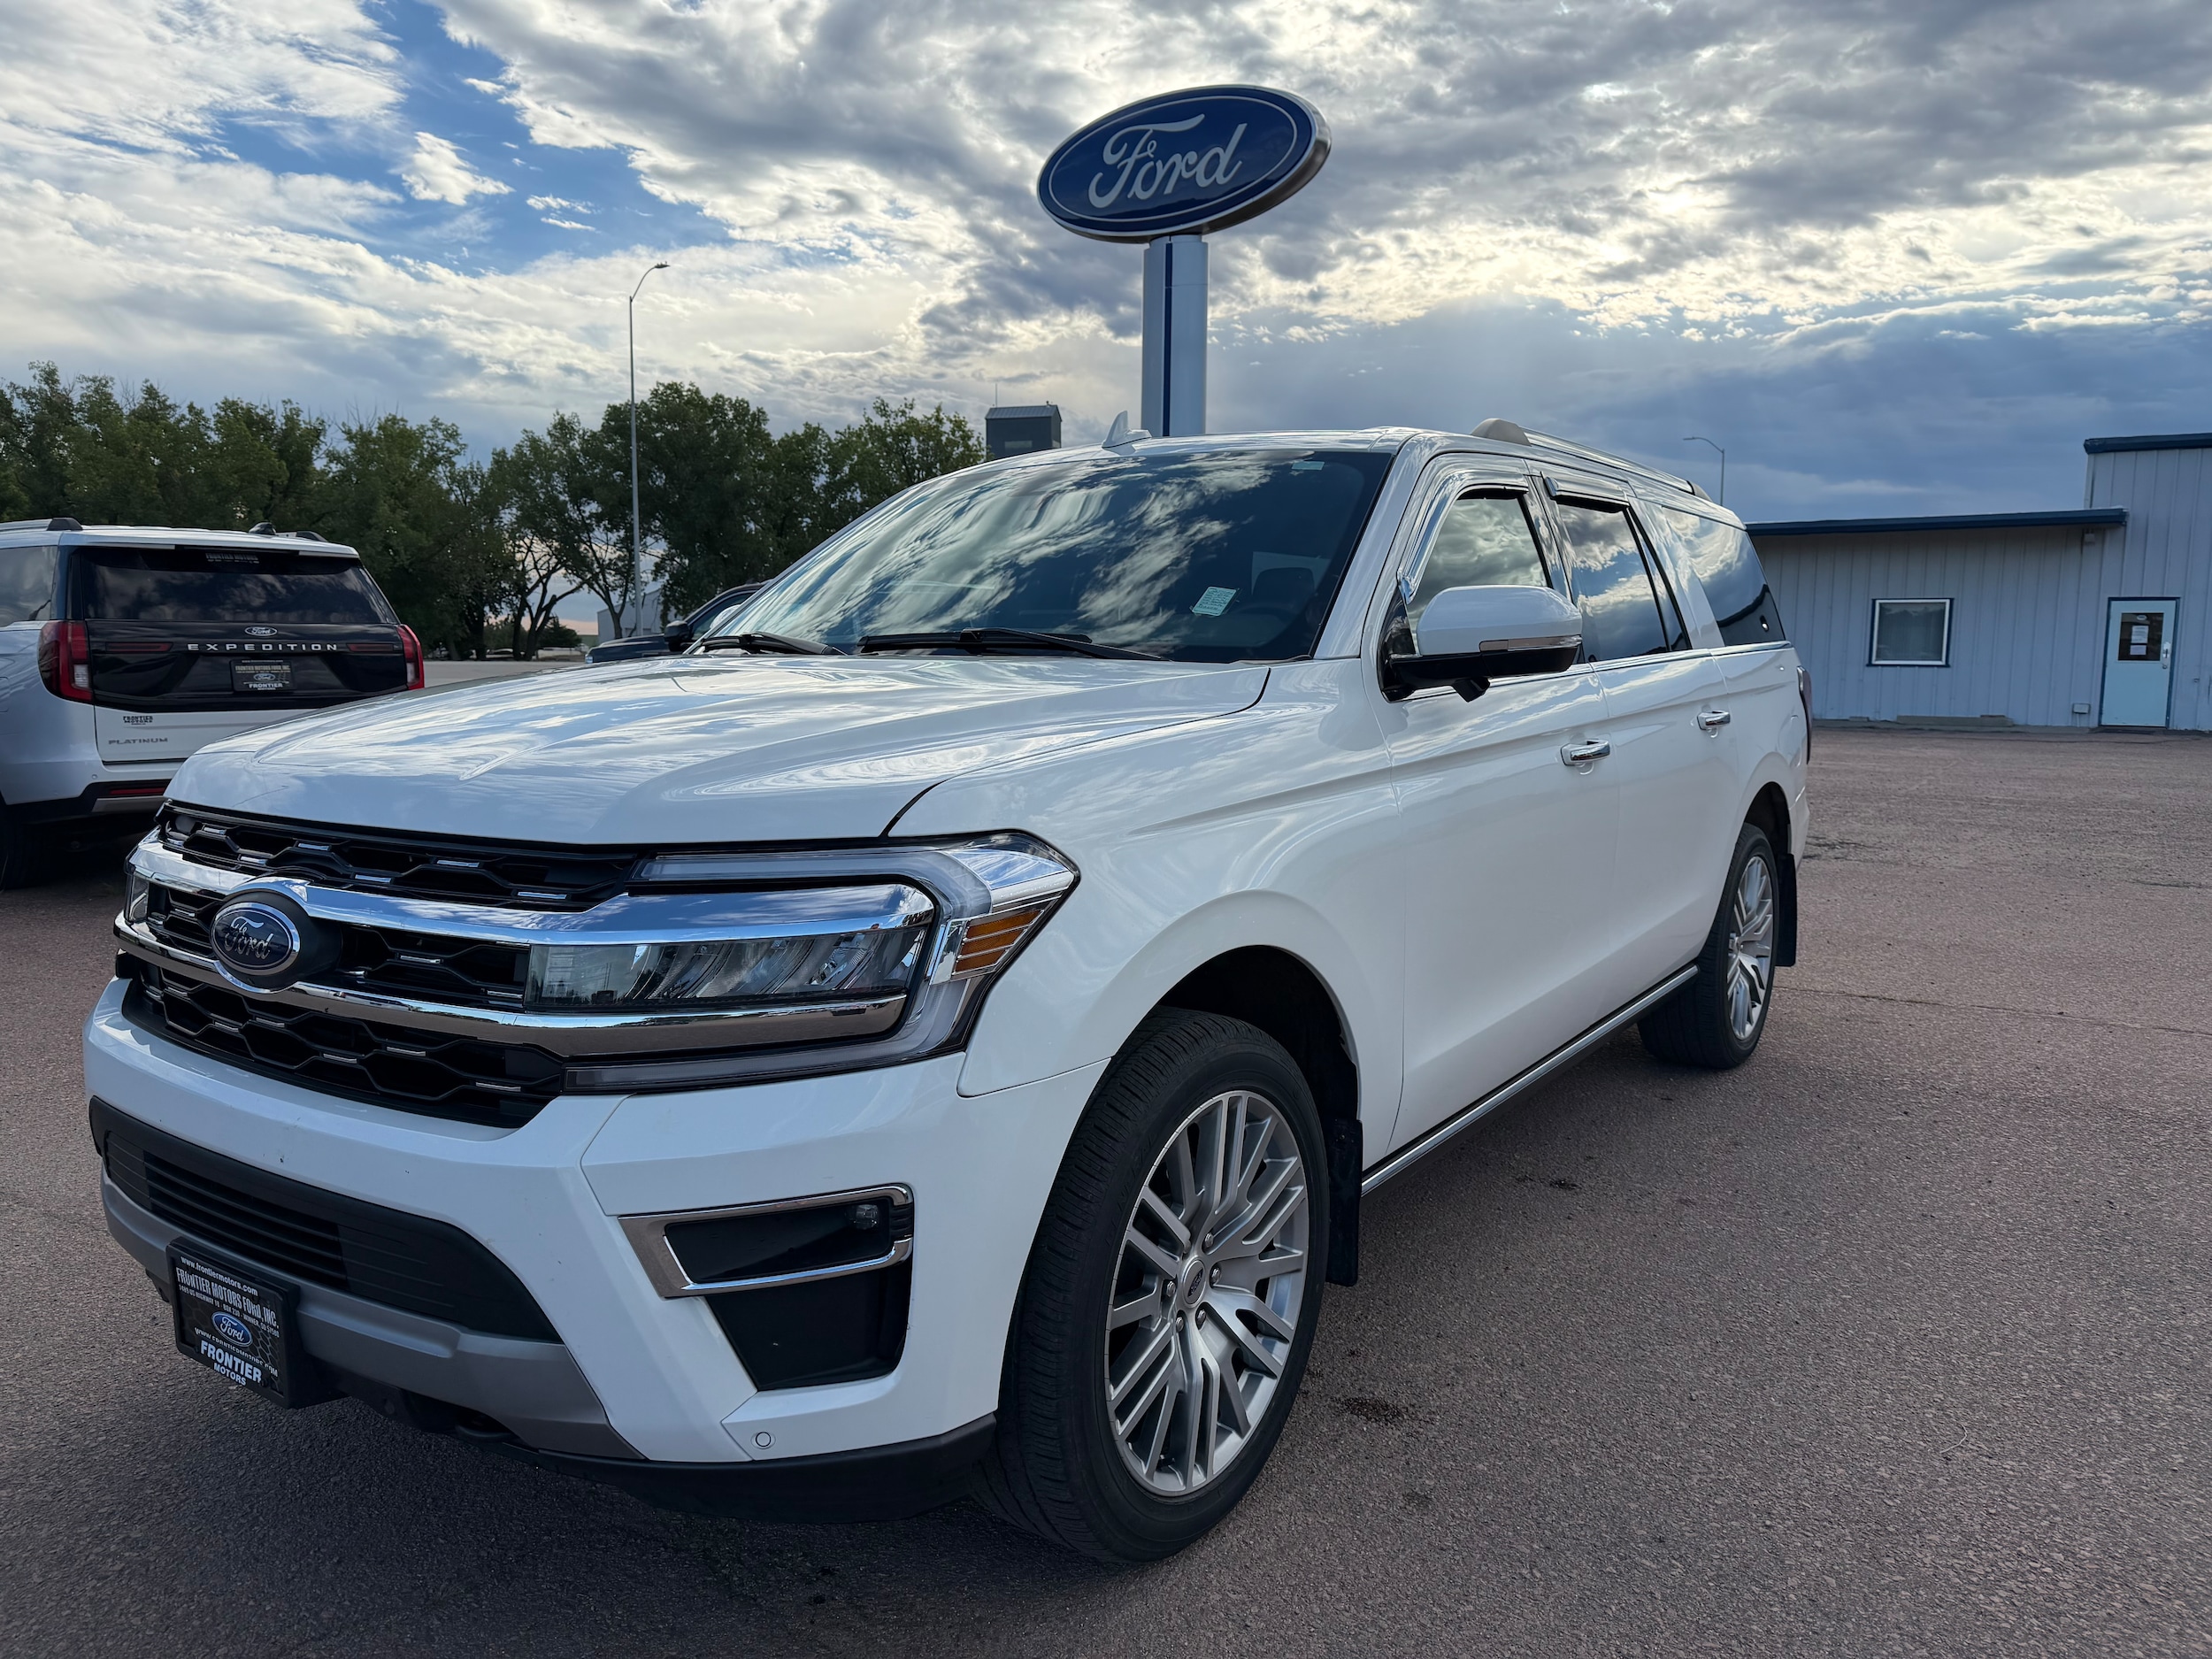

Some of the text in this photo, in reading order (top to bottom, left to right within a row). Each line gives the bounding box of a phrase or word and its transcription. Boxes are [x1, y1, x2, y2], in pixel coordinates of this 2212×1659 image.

[1088, 113, 1248, 209] Ford
[251, 626, 272, 635] Ford
[225, 916, 274, 960] Ford
[180, 1256, 258, 1296] www.frontiermotors.com
[175, 1266, 211, 1295] FRONTIER
[211, 1281, 242, 1309] MOTORS
[263, 1307, 280, 1329] INC.
[220, 1316, 245, 1341] Ford
[200, 1340, 262, 1383] FRONTIER
[213, 1362, 247, 1386] MOTORS
